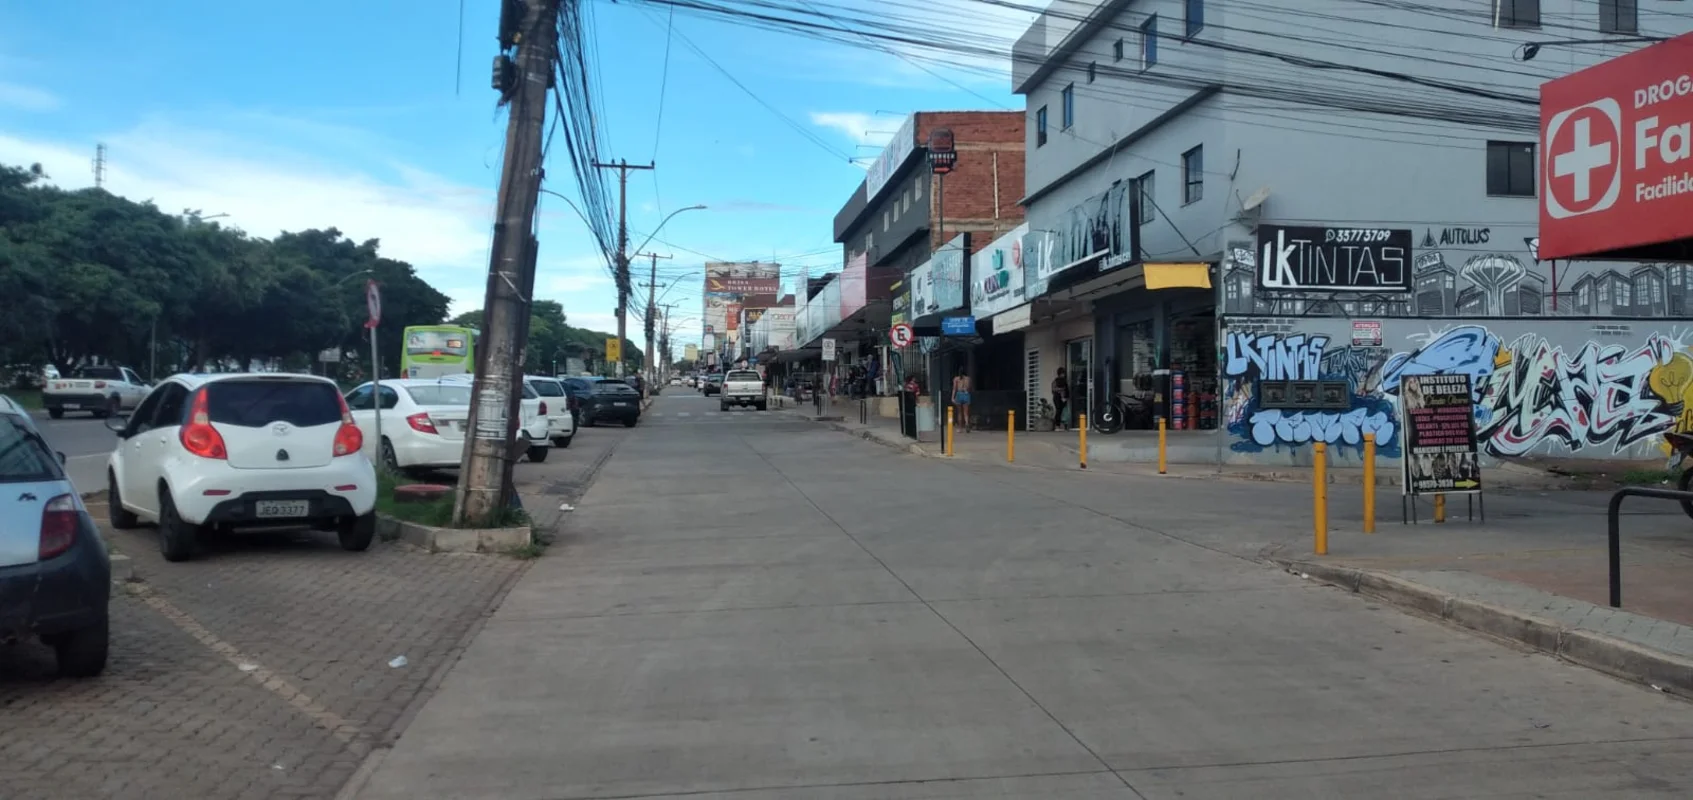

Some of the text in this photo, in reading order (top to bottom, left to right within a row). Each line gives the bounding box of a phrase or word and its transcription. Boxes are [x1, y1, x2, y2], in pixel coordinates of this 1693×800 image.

[1634, 74, 1693, 109] DROG
[1336, 229, 1391, 242] 33773709
[1420, 375, 1466, 384] INSTITUTO
[1422, 384, 1468, 395] DE BELEZA
